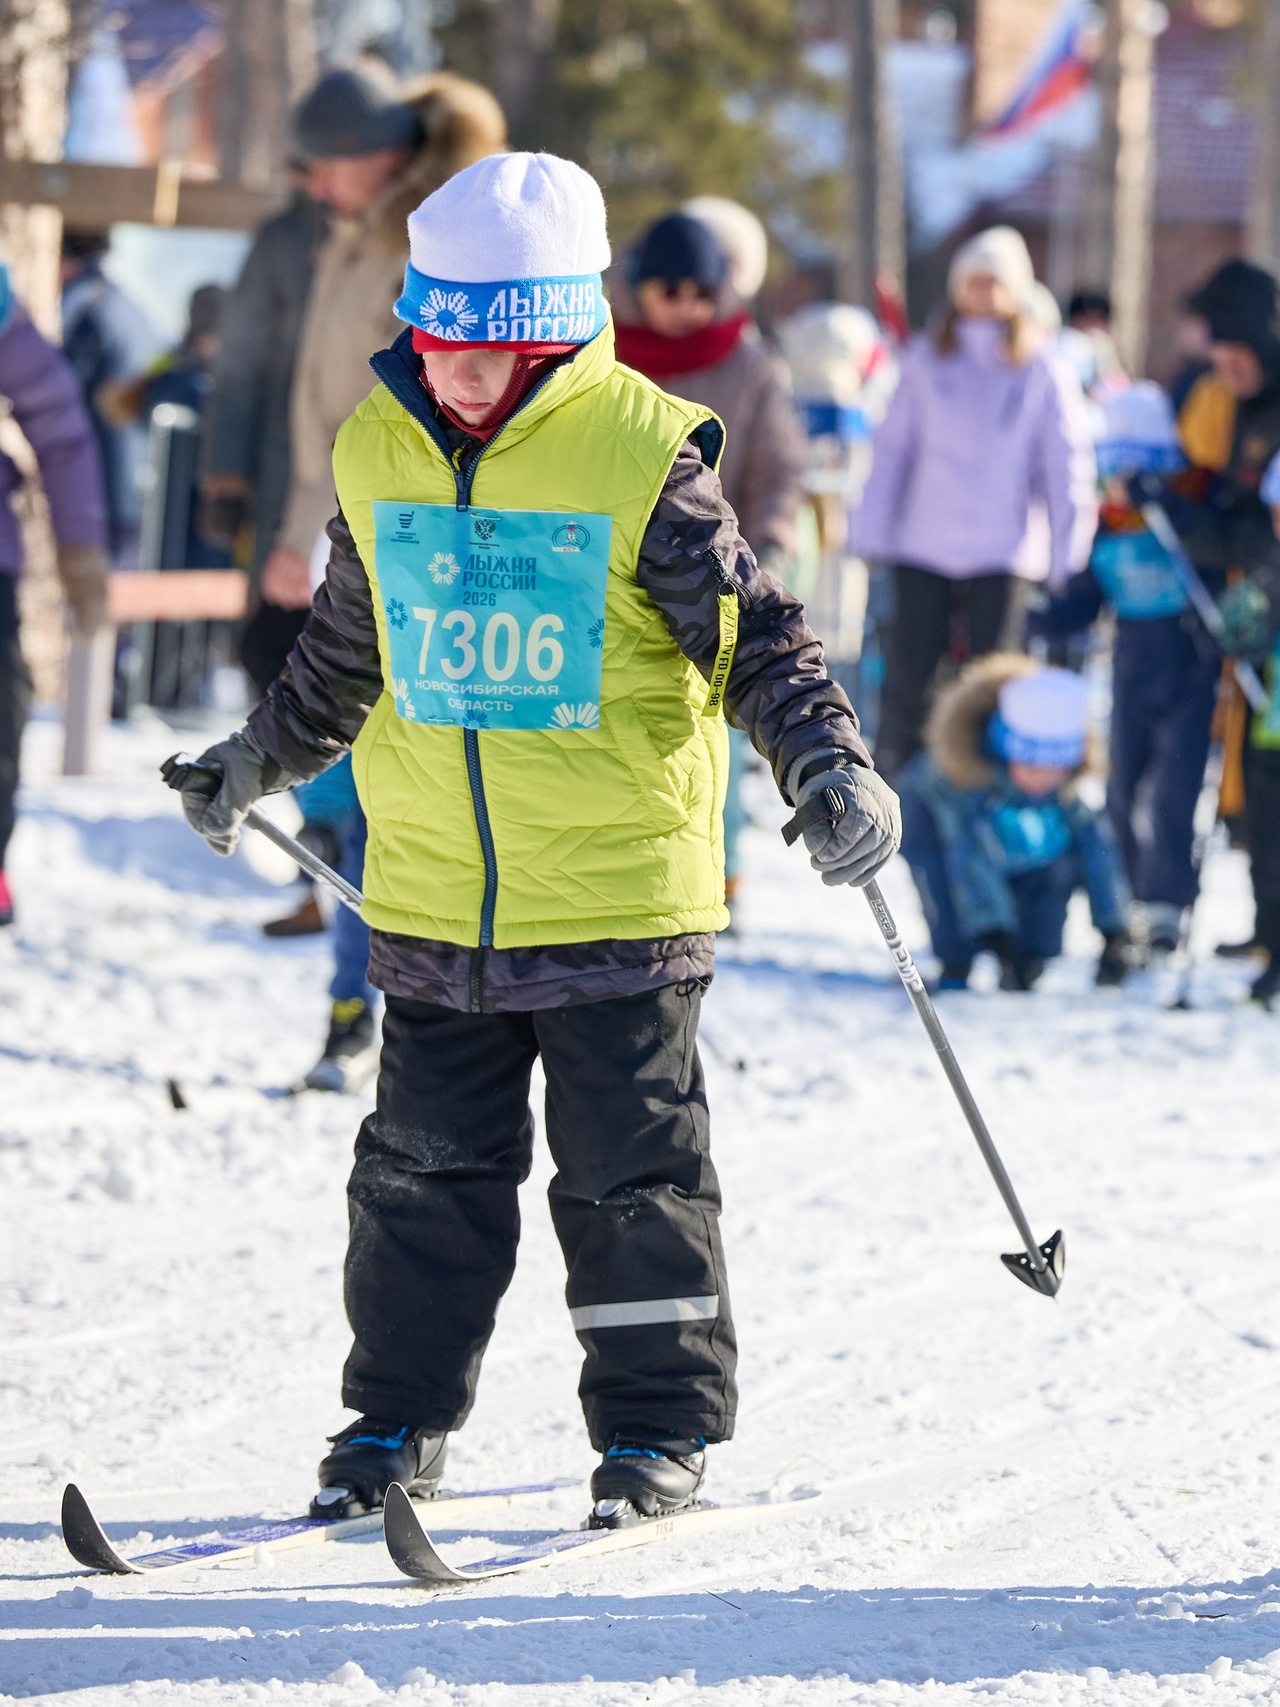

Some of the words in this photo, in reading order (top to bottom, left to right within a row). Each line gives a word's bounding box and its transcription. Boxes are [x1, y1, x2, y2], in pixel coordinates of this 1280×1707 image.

[487, 282, 595, 320] ЛЫЖНЯ
[487, 314, 595, 342] РОССИИ
[464, 554, 537, 574] ЛЫЖНЯ
[463, 571, 537, 590] РОССИИ
[463, 591, 496, 607] 2026
[412, 606, 564, 682] 7306
[414, 678, 559, 696] НОВОСИБИРСКАЯ
[448, 697, 514, 712] ОБЛАСТЬ
[871, 899, 895, 940] Larsen
